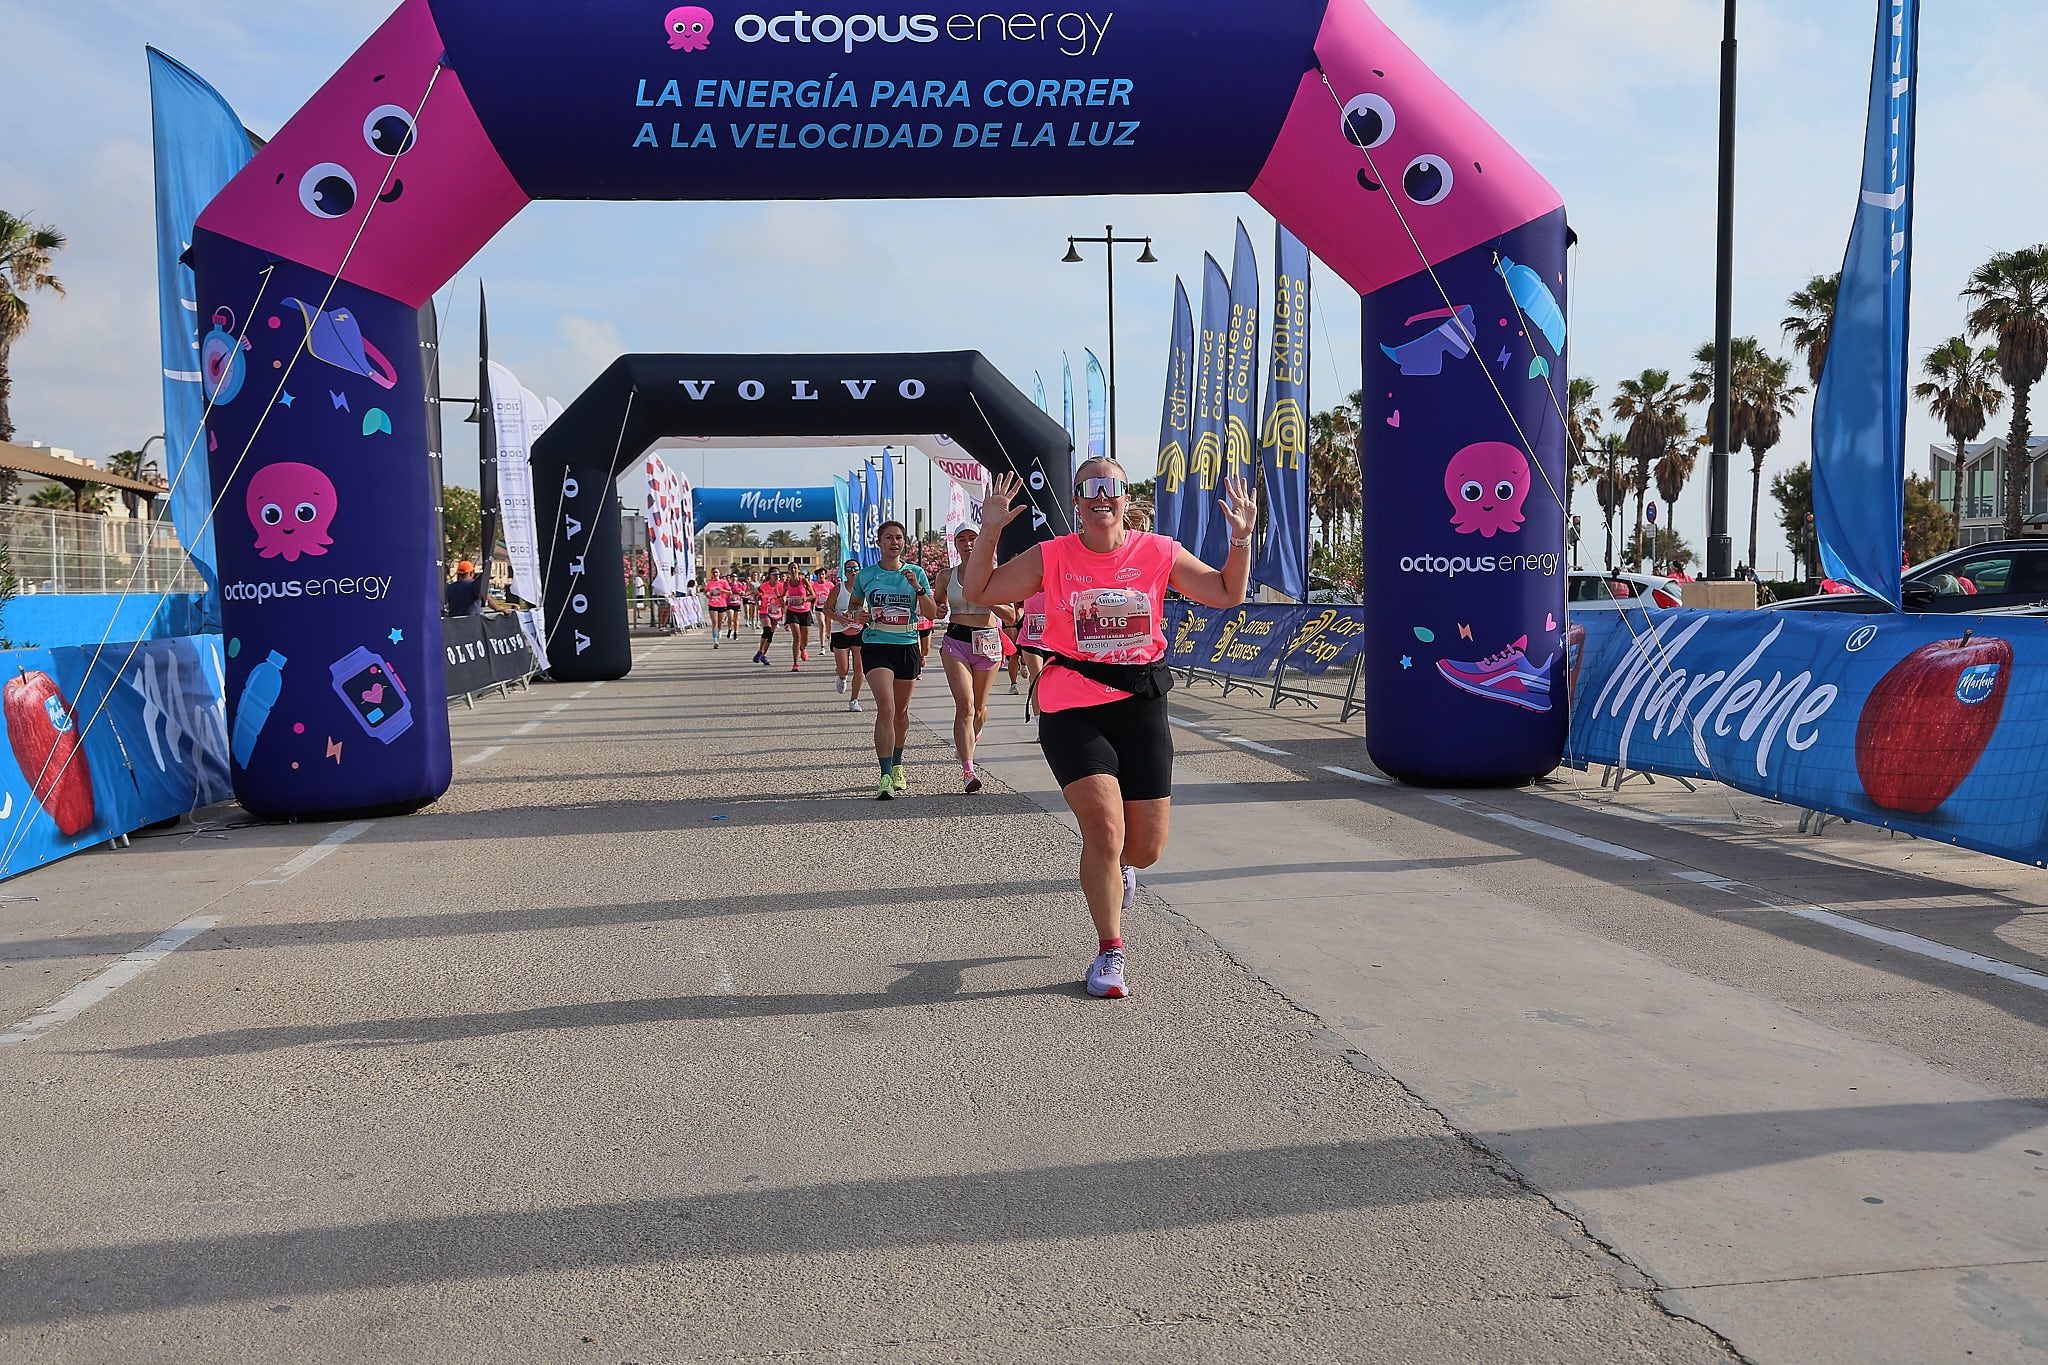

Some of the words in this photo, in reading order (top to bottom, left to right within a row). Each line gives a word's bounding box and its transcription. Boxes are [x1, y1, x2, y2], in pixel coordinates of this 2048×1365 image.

[735, 10, 939, 54] octopus
[946, 11, 1114, 56] energy
[635, 78, 683, 107] LA
[694, 73, 859, 108] ENERGÍA
[870, 79, 972, 108] PARA
[982, 78, 1134, 107] CORRER
[632, 122, 660, 148] A
[670, 122, 718, 149] LA
[729, 122, 945, 149] VELOCIDAD
[952, 122, 1002, 148] DE
[1010, 121, 1057, 148] LA
[1067, 120, 1141, 148] LUZ
[678, 379, 926, 401] VOLVO
[740, 490, 803, 518] Marlene
[563, 478, 591, 655] VOLVO
[1400, 553, 1496, 577] octopus
[1499, 553, 1560, 576] energy
[224, 581, 302, 604] octopus
[305, 575, 392, 600] energy
[1100, 617, 1127, 628] 016
[446, 639, 485, 665] OLVO
[1227, 638, 1262, 663] Express
[1592, 614, 1839, 777] Marlene
[1958, 673, 1995, 695] Marlene
